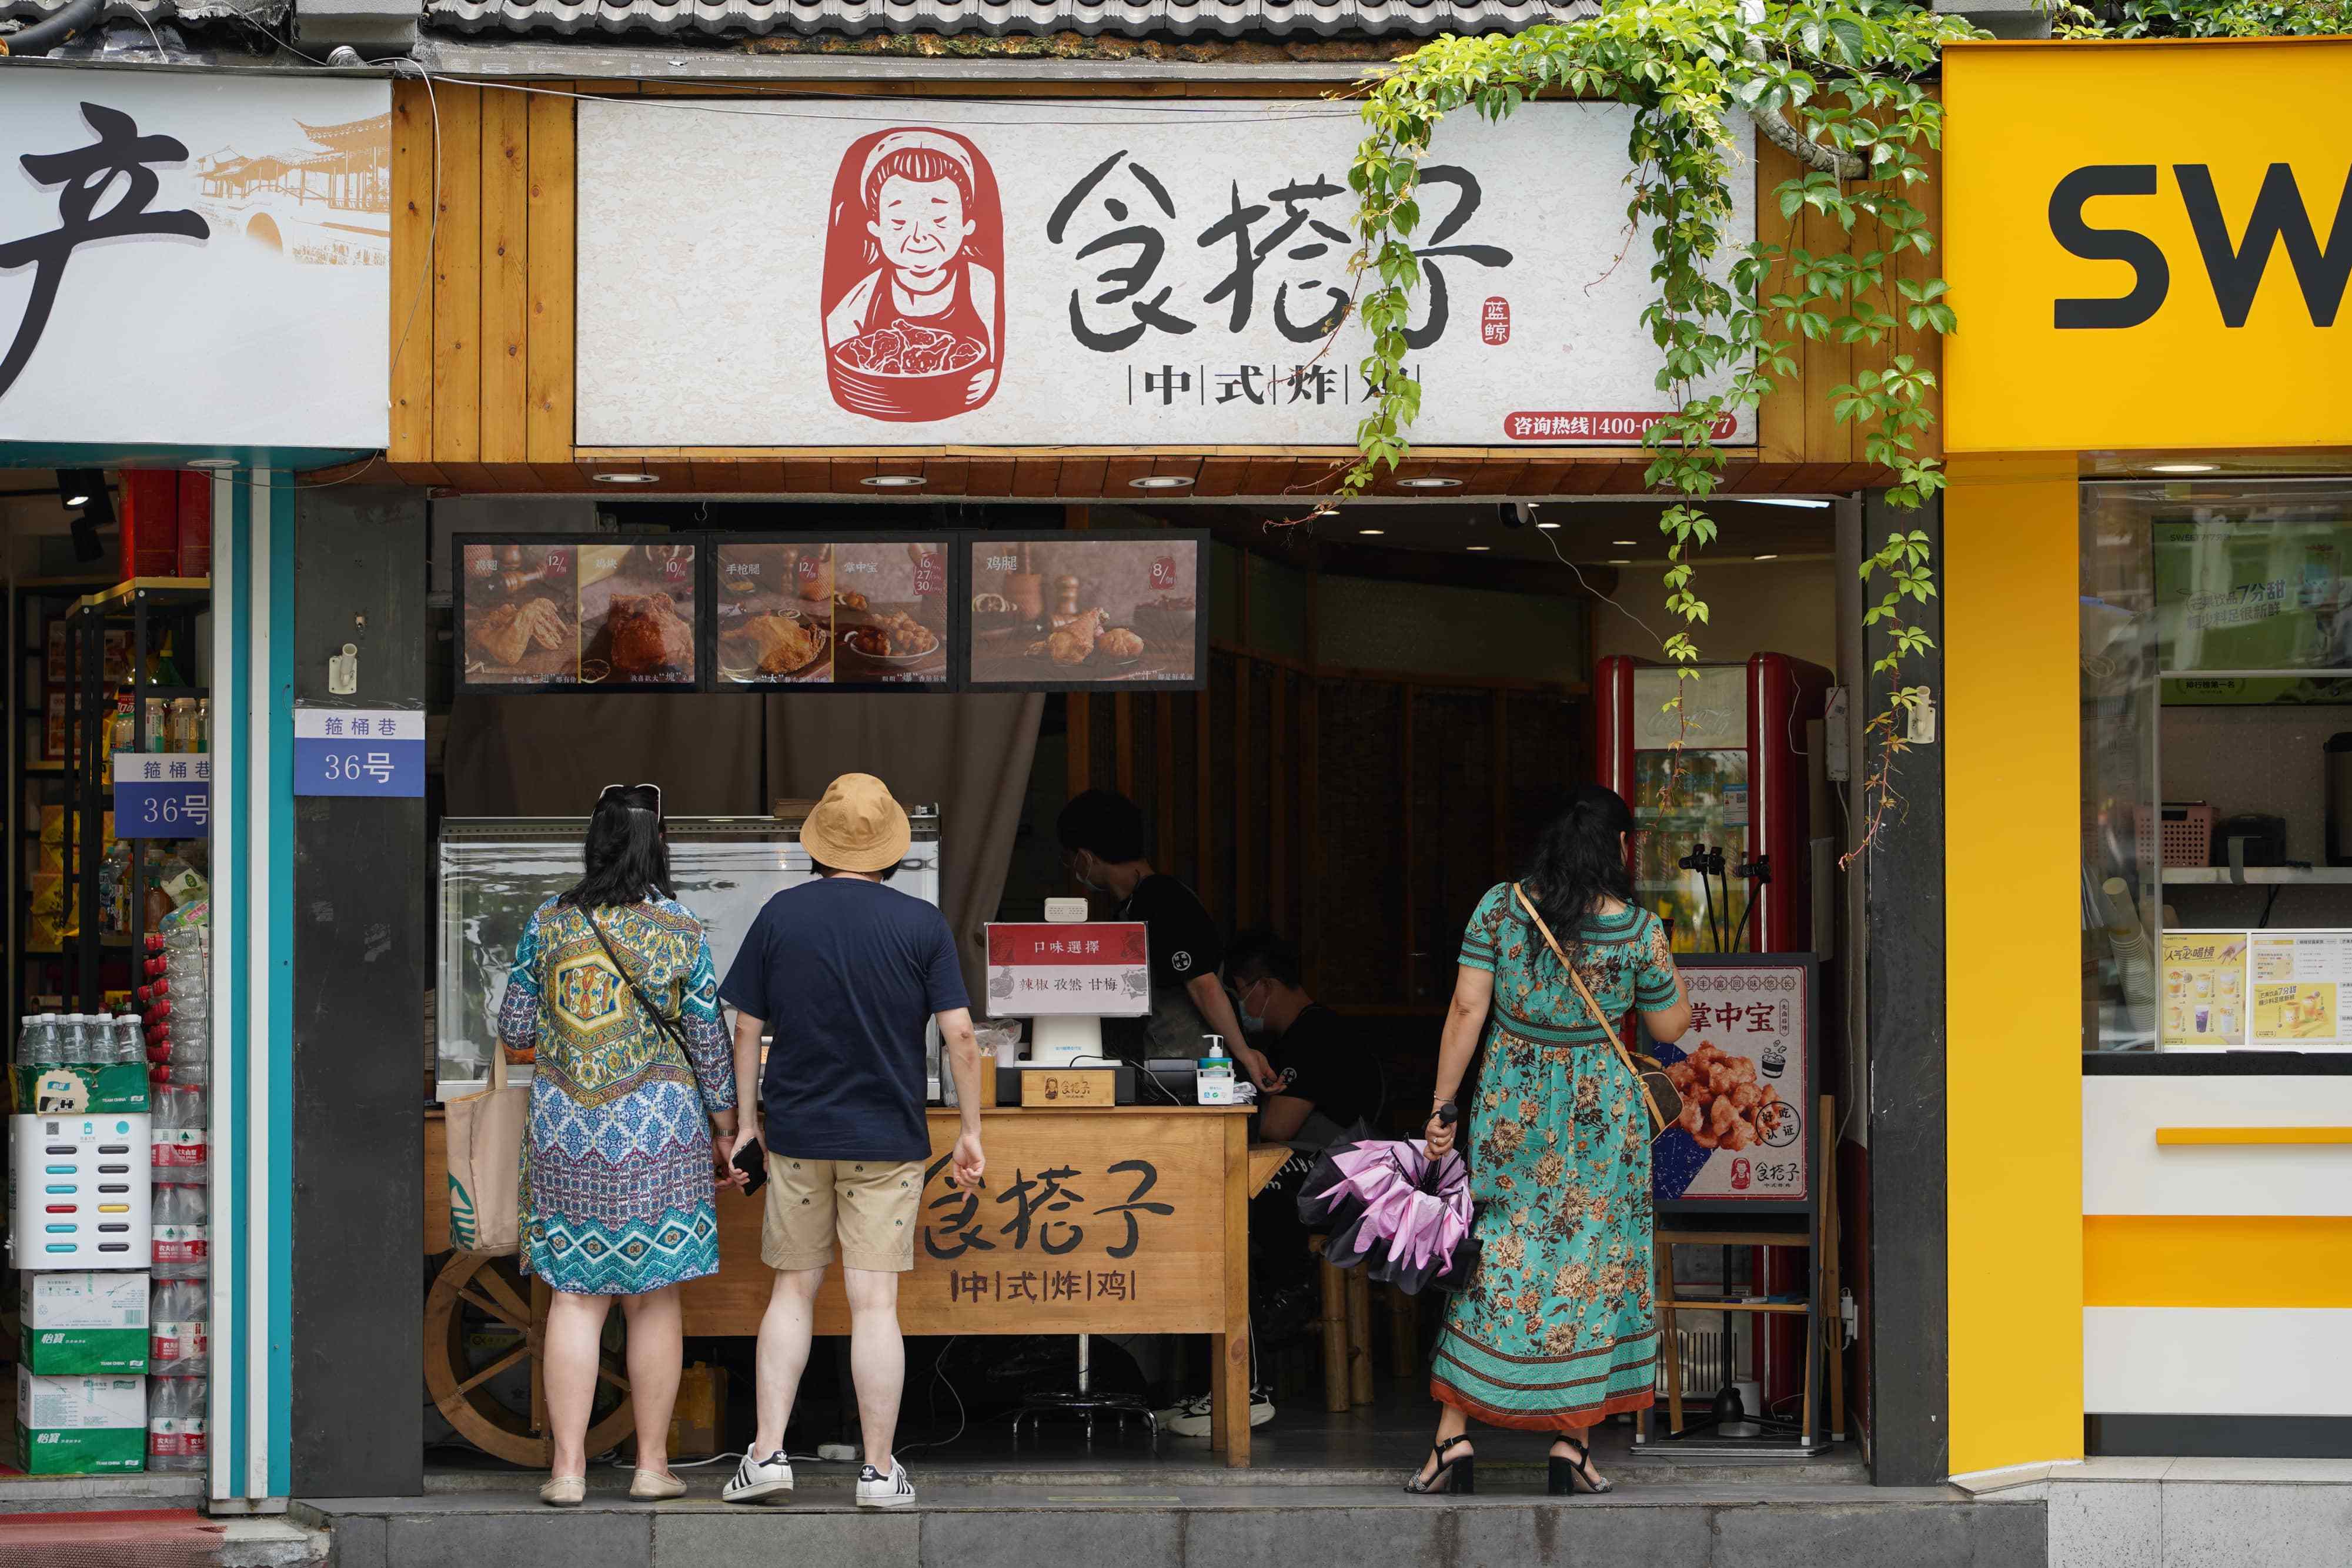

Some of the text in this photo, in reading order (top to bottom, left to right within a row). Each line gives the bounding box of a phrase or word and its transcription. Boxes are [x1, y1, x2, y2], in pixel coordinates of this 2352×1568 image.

[1047, 149, 1513, 352] 食搭子
[1484, 300, 1508, 342] 蓝鲸
[325, 717, 397, 736] 箍桶巷
[143, 761, 209, 779] 箍桶巷
[325, 753, 395, 784] 36号
[143, 795, 209, 825] 36号
[1034, 940, 1101, 954] 口味選擇
[1020, 977, 1117, 992] 辣椒 孜然 甘梅
[1689, 1002, 1775, 1033] 掌中宝
[1766, 1124, 1795, 1140] 认证
[1755, 1161, 1799, 1181] 食搭子
[924, 1151, 1175, 1259] 食搭子
